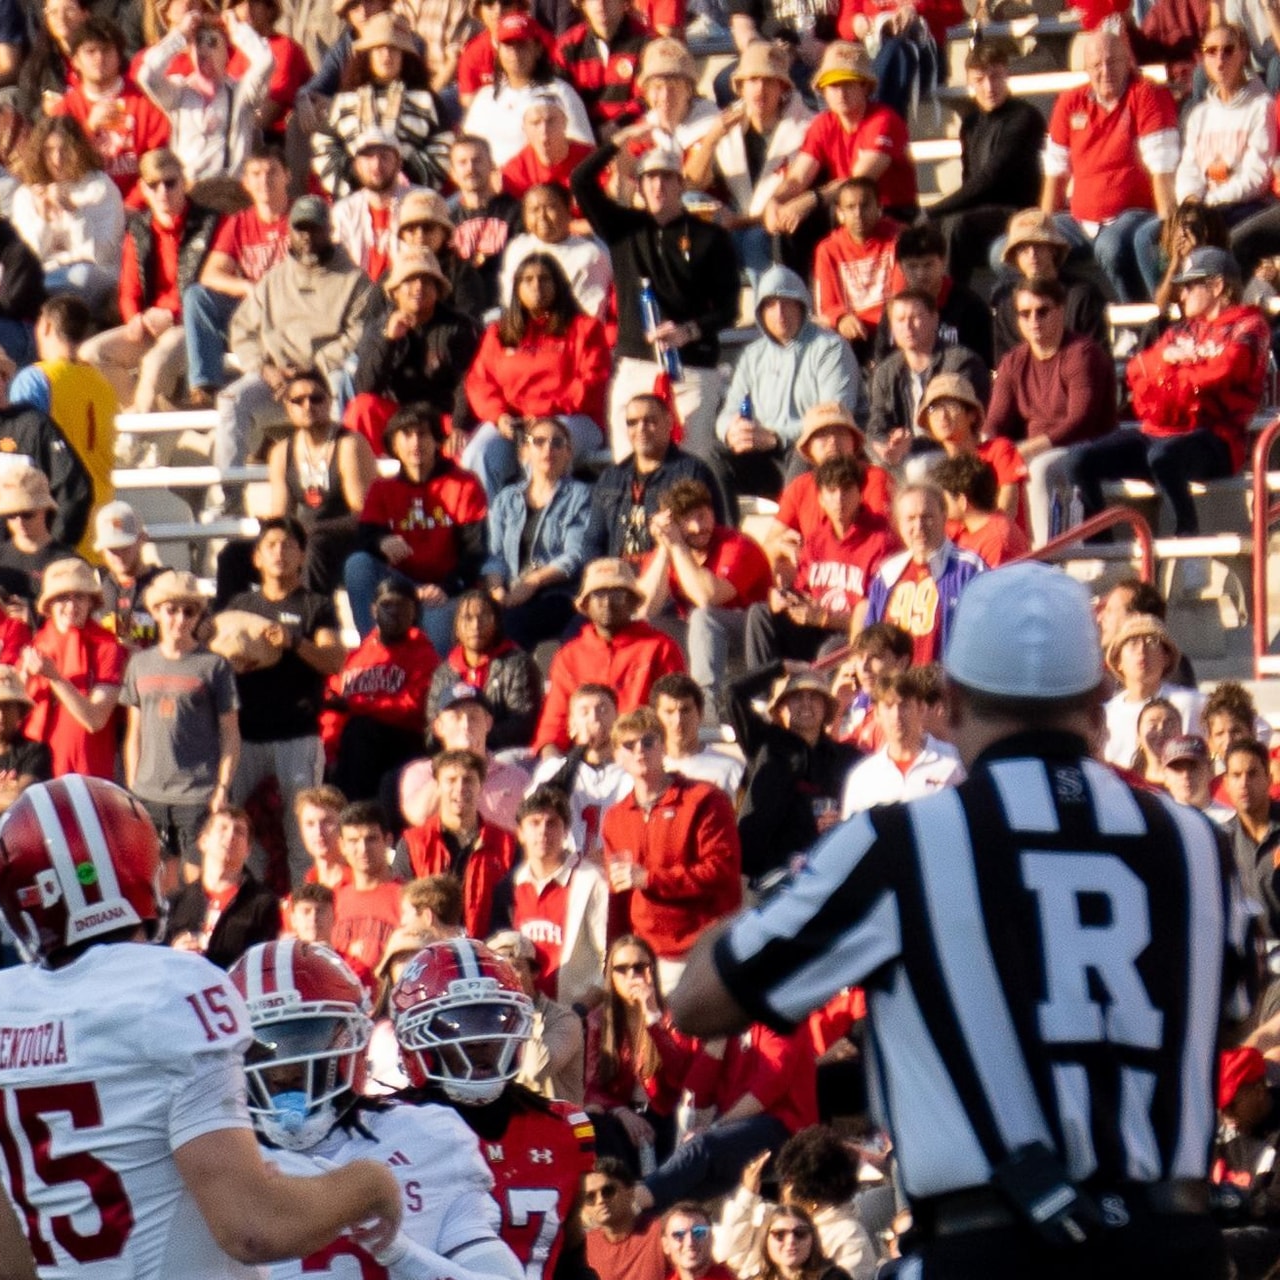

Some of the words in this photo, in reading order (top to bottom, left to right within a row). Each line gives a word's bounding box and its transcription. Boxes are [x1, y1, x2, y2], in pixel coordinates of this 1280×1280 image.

[74, 906, 128, 933] INDIANA
[1020, 850, 1165, 1050] R
[185, 984, 240, 1042] 15
